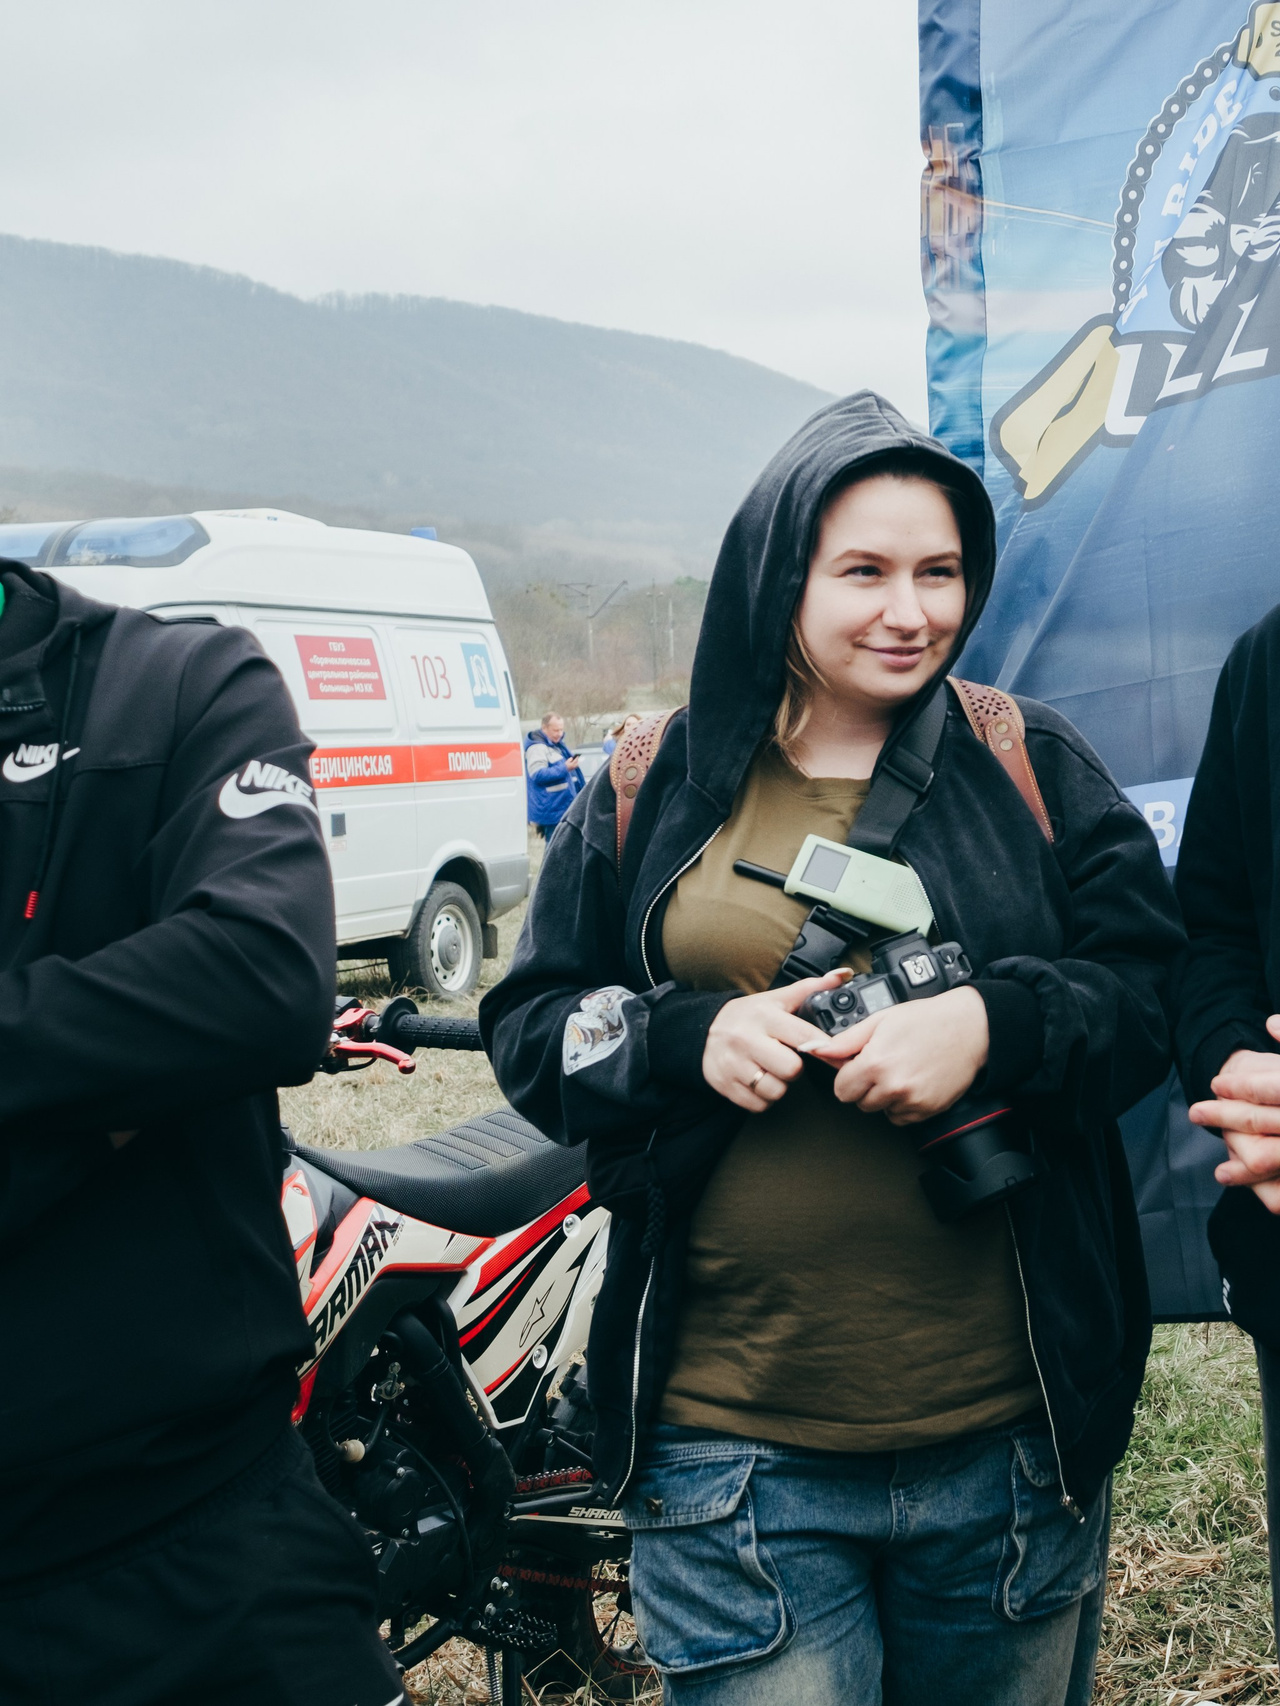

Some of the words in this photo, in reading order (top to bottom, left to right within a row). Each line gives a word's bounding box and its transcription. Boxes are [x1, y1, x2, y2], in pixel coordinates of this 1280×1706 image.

[1160, 80, 1243, 218] RIDE
[329, 641, 346, 652] ГБУЗ
[307, 670, 349, 681] центральная
[348, 669, 379, 681] районная
[410, 655, 452, 699] 103
[448, 752, 492, 773] ПОМОЩЬ
[240, 760, 314, 798] NIKE
